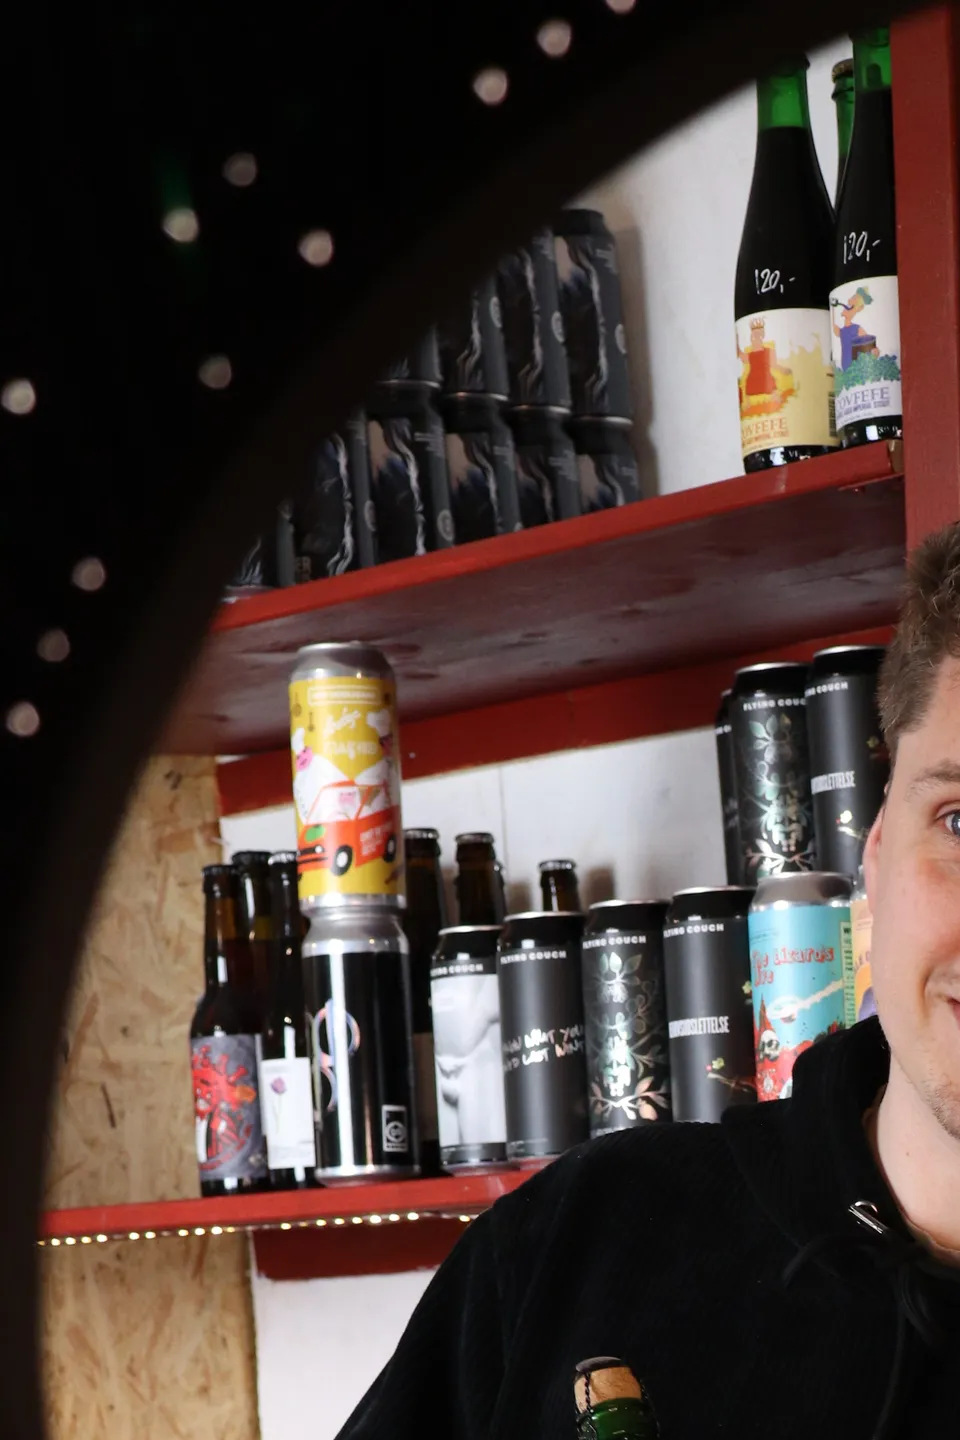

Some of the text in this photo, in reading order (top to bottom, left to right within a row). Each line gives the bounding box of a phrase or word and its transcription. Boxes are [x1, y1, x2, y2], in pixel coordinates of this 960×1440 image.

[816, 681, 849, 694] COUCH
[777, 698, 807, 707] COUC
[686, 923, 725, 934] COUCH
[608, 935, 647, 946] COUCH
[528, 950, 567, 961] COUCH
[448, 963, 484, 974] COUCH
